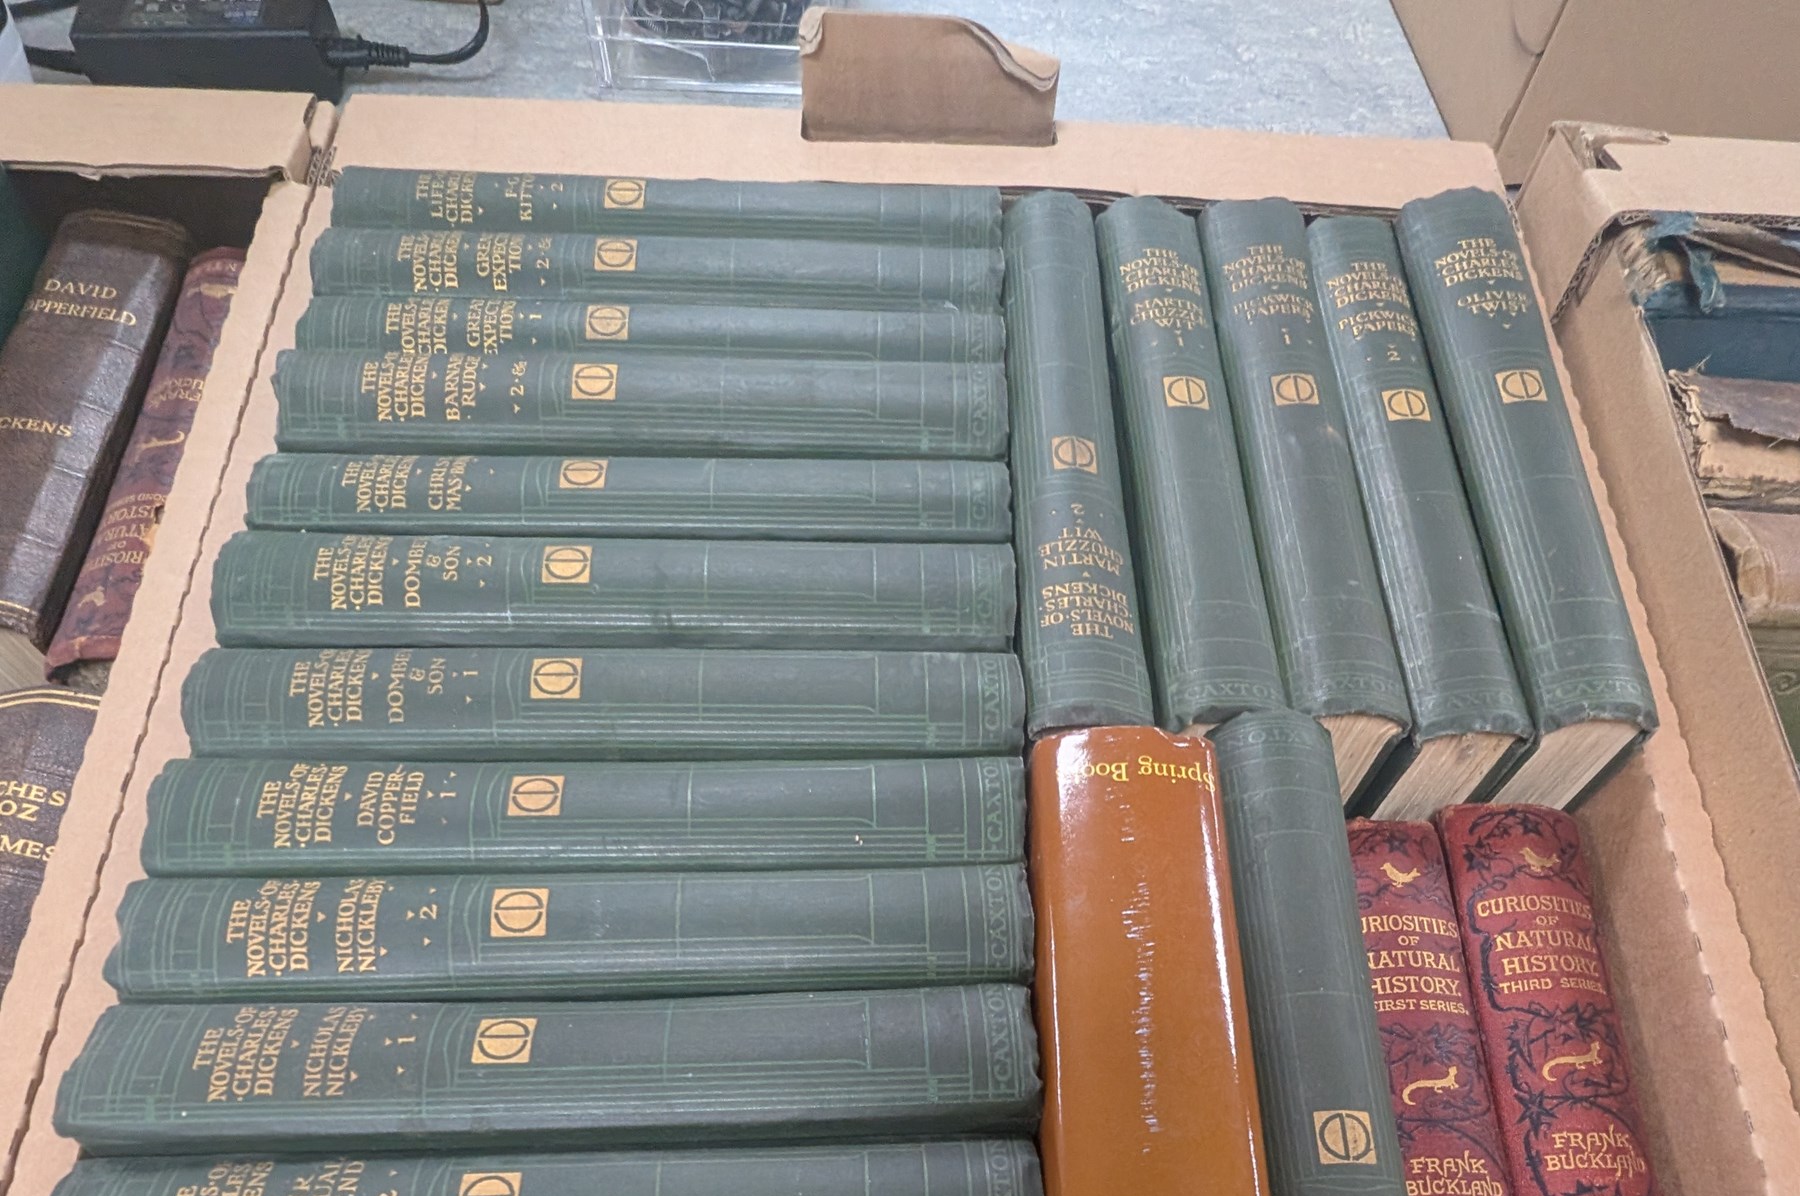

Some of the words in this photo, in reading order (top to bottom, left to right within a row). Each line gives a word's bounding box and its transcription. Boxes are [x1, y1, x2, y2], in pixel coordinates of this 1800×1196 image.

[551, 182, 564, 192] 2
[1434, 248, 1498, 269] NOVELS
[1457, 238, 1496, 249] THE
[43, 278, 118, 300] DAVID
[386, 303, 401, 334] THE
[1387, 351, 1401, 361] 2
[361, 361, 378, 394] THE
[462, 355, 480, 407] RUDGE
[0, 416, 72, 438] CKENS
[1070, 502, 1085, 515] 2
[1058, 526, 1103, 542] WIT
[313, 547, 334, 581] THE
[426, 554, 441, 568] &
[442, 545, 461, 581] SON
[476, 555, 492, 567] 2
[1037, 539, 1125, 566] CHUZZLE
[1043, 552, 1121, 577] MARTIN
[330, 547, 352, 610] NOVELS
[1040, 581, 1128, 608] DICKENS
[1070, 610, 1135, 636] NOVELS
[1070, 623, 1115, 640] THE
[288, 661, 311, 697] THE
[409, 667, 426, 682] &
[426, 657, 447, 695] SON
[308, 661, 329, 728] NOVELS
[1057, 762, 1129, 785] Boo
[1138, 755, 1216, 792] Spring
[256, 781, 281, 818] THE
[295, 767, 328, 842] CHARLES
[314, 766, 348, 842] DICKENS
[357, 771, 385, 827] DAVID
[399, 771, 425, 825] FIELD
[274, 782, 300, 848] NOVELS
[226, 899, 252, 944] THE
[419, 903, 438, 920] 2
[1477, 895, 1592, 920] CURIOSITIES
[1536, 915, 1559, 926] OF
[246, 900, 271, 978] NOVELS
[268, 883, 298, 971] CHARLES
[289, 881, 322, 972] DICKENS
[335, 879, 366, 973] NICHOLAS
[356, 879, 387, 973] NICKLEBY
[1398, 935, 1420, 946] OF
[1495, 929, 1596, 954] NATURAL
[1499, 978, 1553, 994] THIRD
[1420, 1000, 1470, 1015] SERIES.
[192, 1027, 225, 1071] THE
[232, 1010, 276, 1096] CHARLES
[254, 1008, 300, 1096] DICKENS
[303, 1006, 348, 1097] NICHOLAS
[325, 1007, 369, 1097] NICKLEBY
[398, 1036, 417, 1044] 1
[207, 1027, 244, 1103] NOVELS
[1552, 1124, 1635, 1152] FRANK
[1409, 1150, 1488, 1176] FRANK
[1544, 1149, 1646, 1180] BUCKLAND
